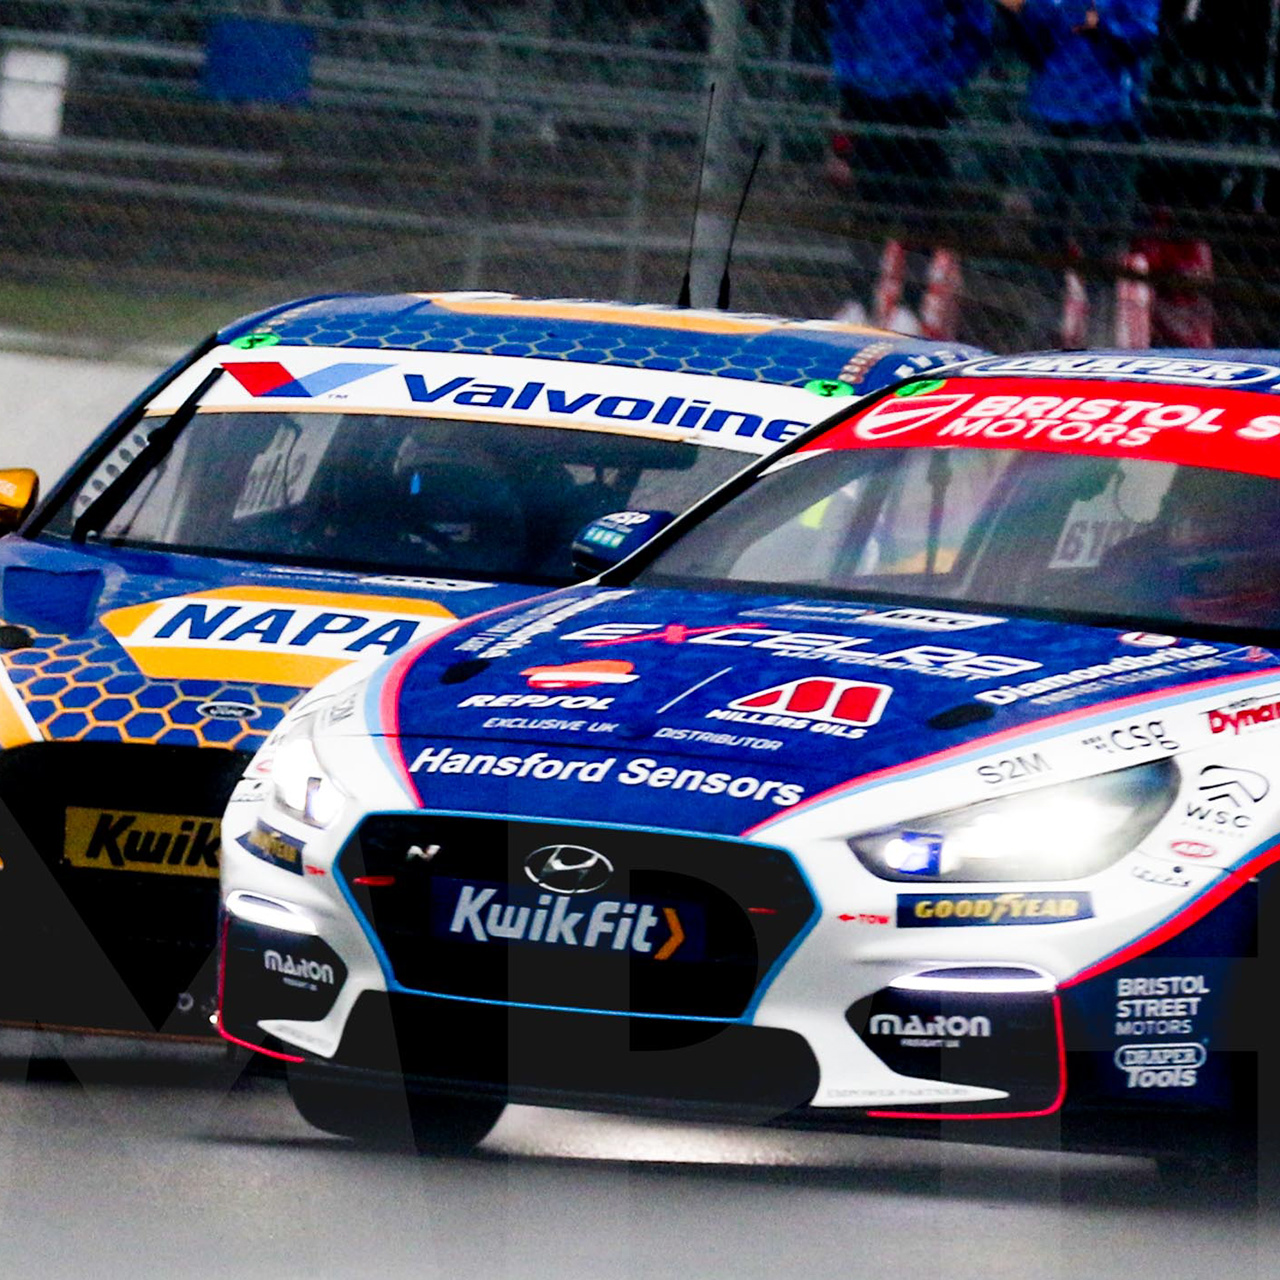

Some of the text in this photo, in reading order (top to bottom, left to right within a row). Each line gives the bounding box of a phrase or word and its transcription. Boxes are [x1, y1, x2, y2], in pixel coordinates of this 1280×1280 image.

[403, 373, 811, 442] Valvoline
[961, 395, 1226, 433] BRISTOL
[938, 417, 1160, 447] MOTORS
[155, 596, 421, 656] NAPA
[457, 694, 616, 711] REPSOL
[482, 717, 620, 733] EXCLUSIVE UK
[705, 708, 869, 740] MILLERS OILS
[654, 726, 784, 752] DISTRIBUTOR
[409, 747, 806, 807] Hansford Sensors
[85, 812, 222, 868] Kwik
[914, 894, 1079, 923] GOODYEAR
[1117, 975, 1211, 996] BRISTOL
[1116, 997, 1202, 1018] STREET
[1114, 1019, 1193, 1036] MOTORS
[1123, 1048, 1197, 1066] DRAPER
